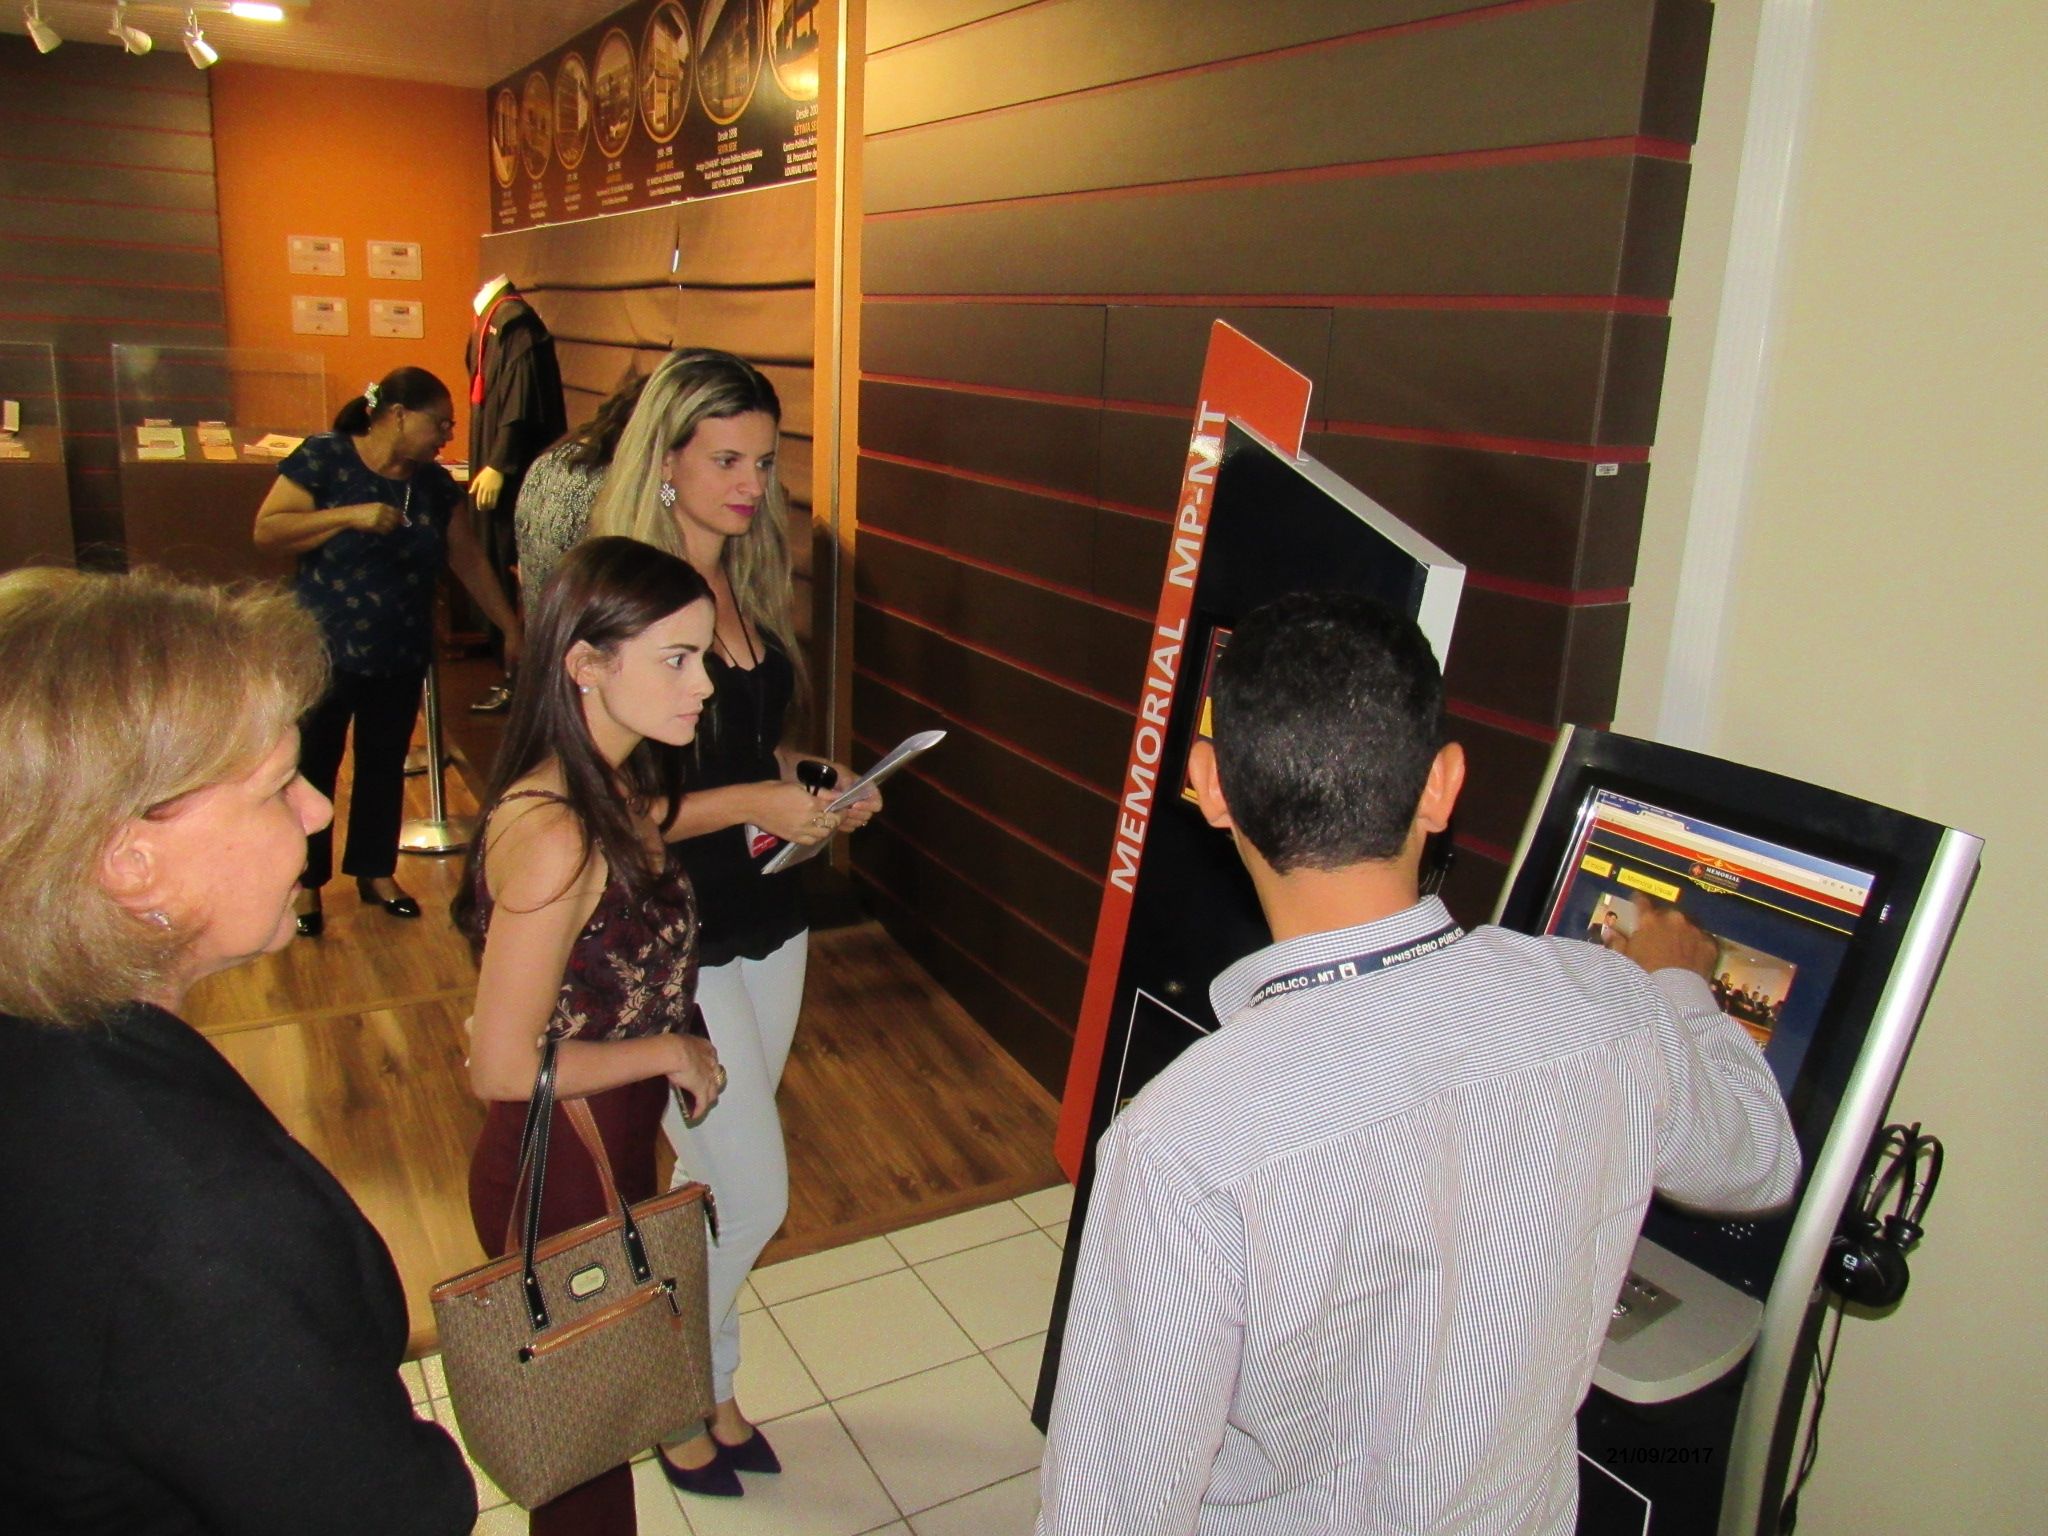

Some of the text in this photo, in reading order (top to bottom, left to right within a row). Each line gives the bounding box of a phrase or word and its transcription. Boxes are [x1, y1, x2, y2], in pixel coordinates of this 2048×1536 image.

[796, 106, 809, 120] Desde
[1111, 618, 1185, 893] MEMORIAL
[1382, 941, 1438, 967] MINISTÉRIO
[1265, 976, 1308, 997] PÚBLICO
[1317, 970, 1335, 985] MT
